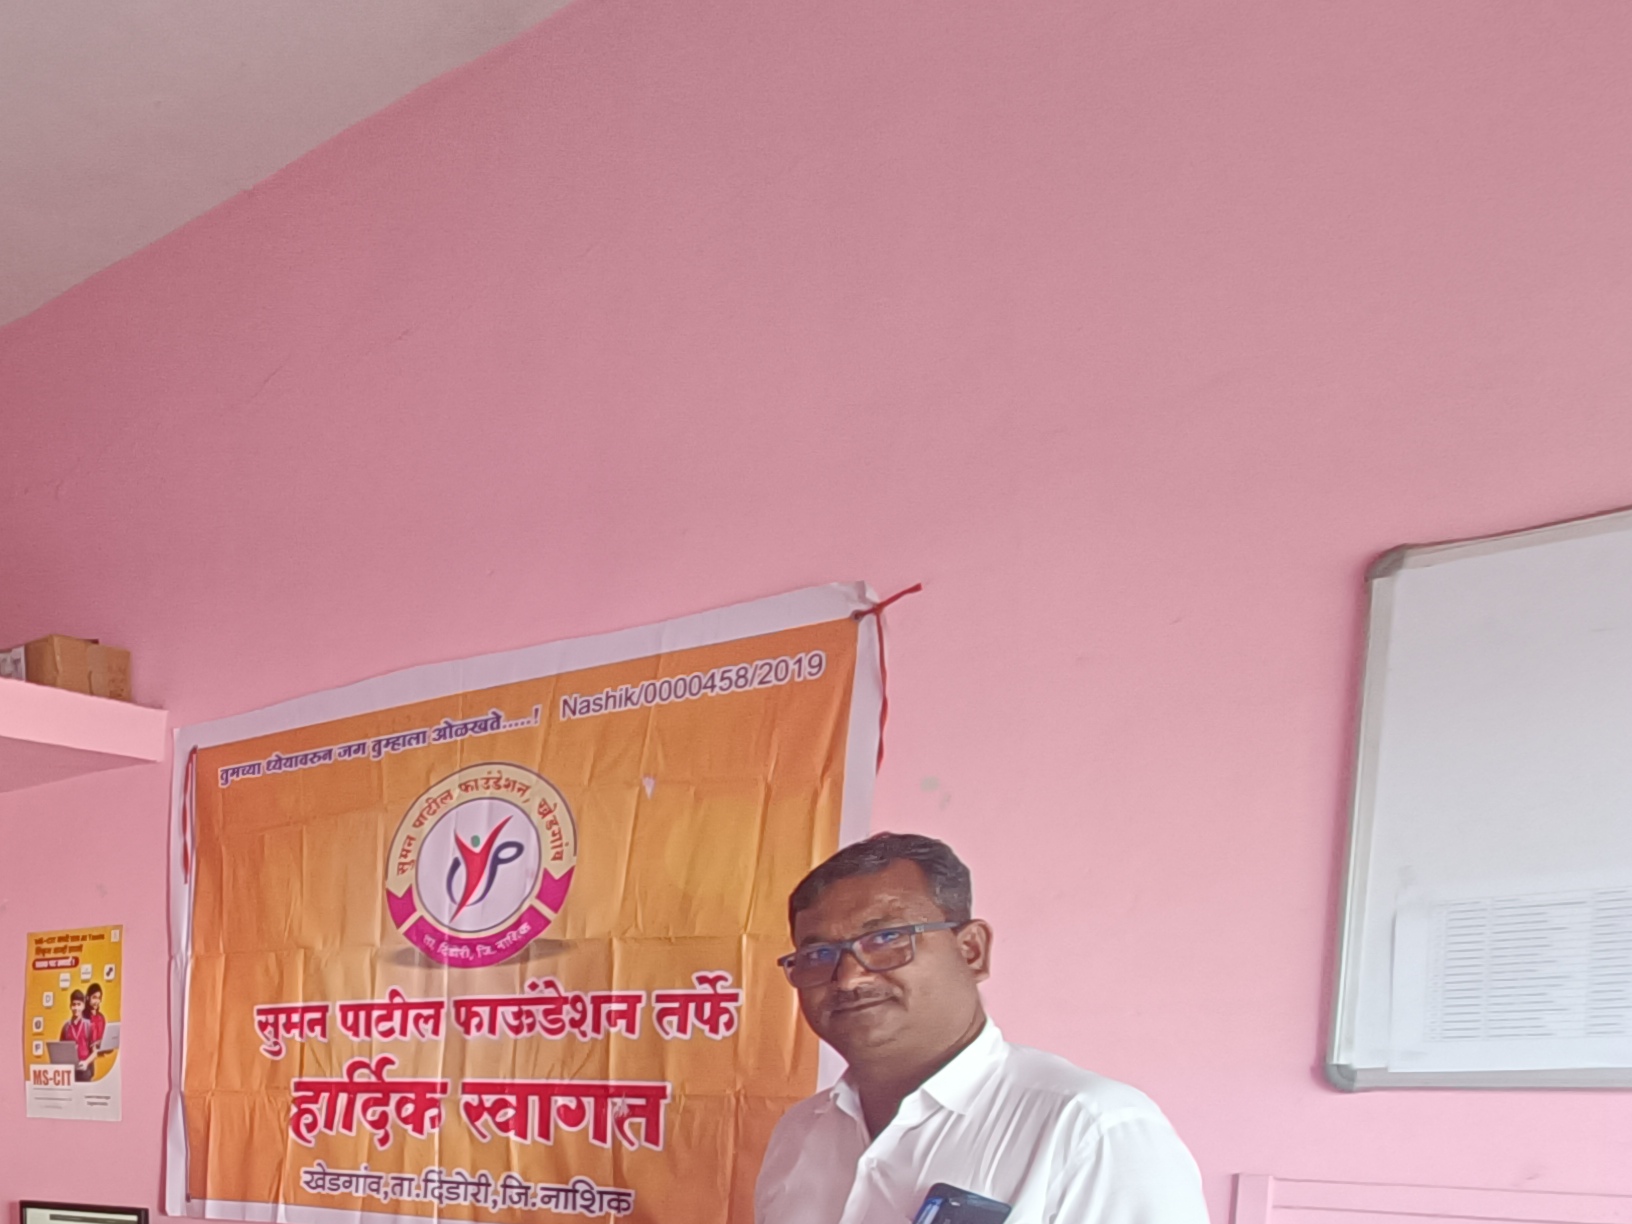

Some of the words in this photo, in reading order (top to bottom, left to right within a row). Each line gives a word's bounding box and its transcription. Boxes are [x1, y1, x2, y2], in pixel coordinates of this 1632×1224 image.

[562, 653, 823, 718] Nashik/0000458/2019
[397, 835, 416, 875] सुमन
[412, 789, 453, 828] पाटील
[255, 1004, 328, 1057] सुमन
[338, 987, 445, 1040] पाटील
[454, 979, 643, 1041] फाऊंडेशन
[655, 972, 741, 1039] तर्फे
[33, 1070, 71, 1087] MS-CIT
[291, 1056, 448, 1149] हार्दिक
[462, 1081, 669, 1149] स्वागत
